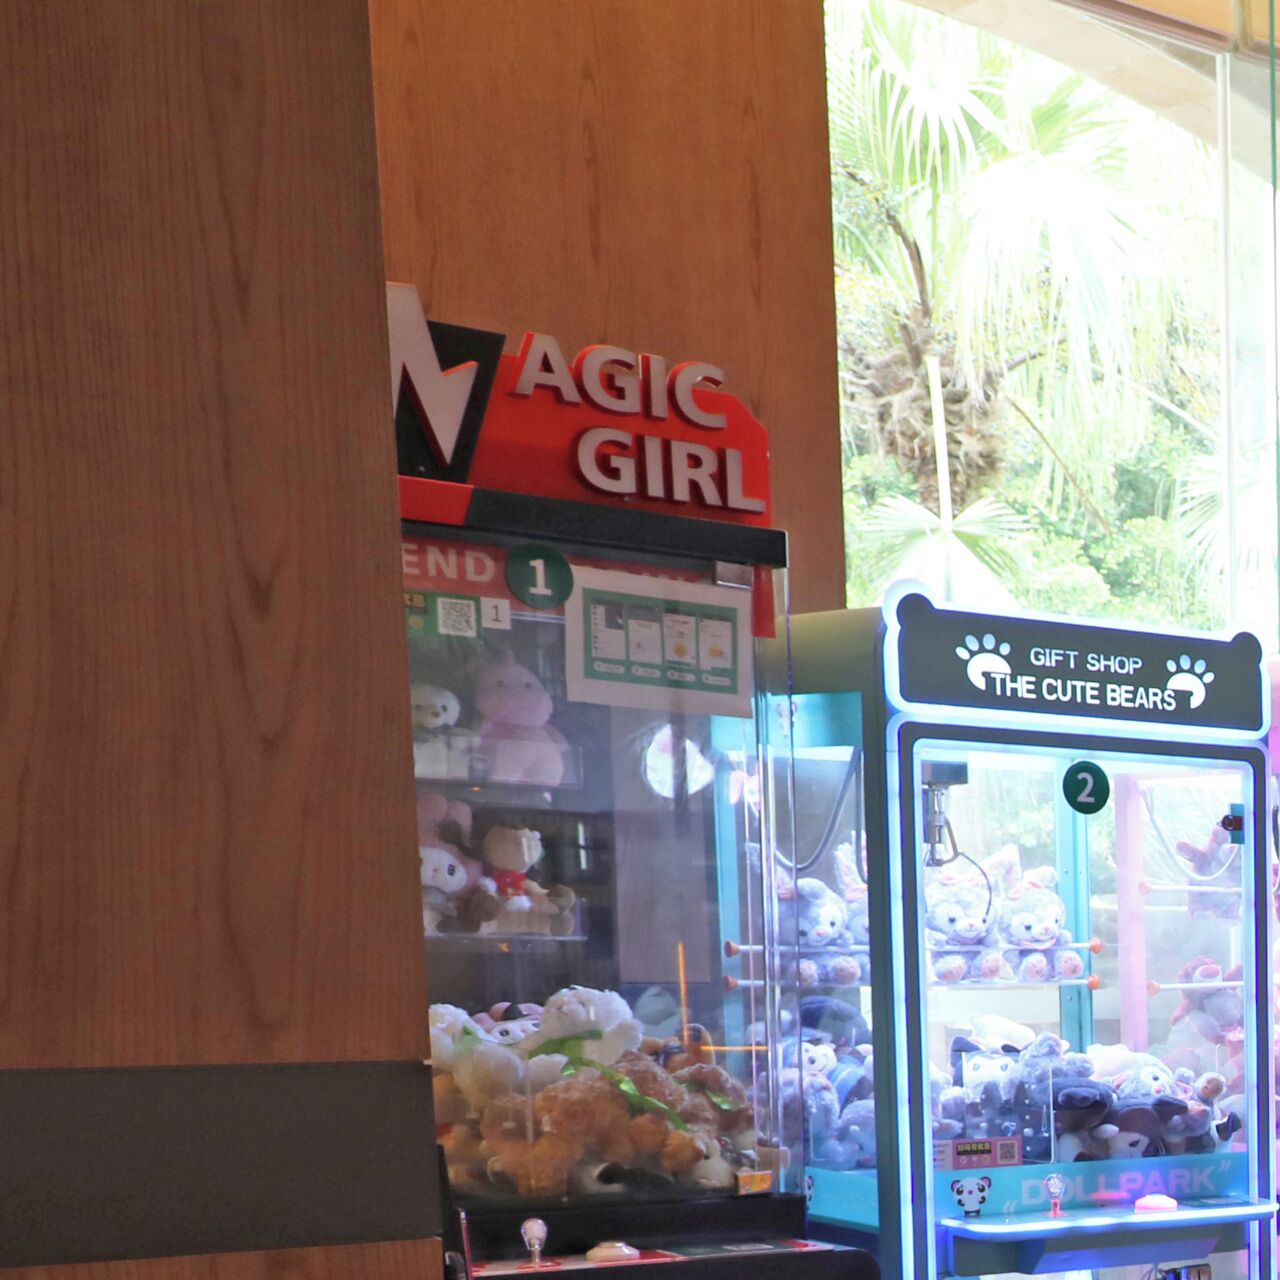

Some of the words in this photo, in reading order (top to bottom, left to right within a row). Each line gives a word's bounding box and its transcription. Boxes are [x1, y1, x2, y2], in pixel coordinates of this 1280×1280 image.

[576, 427, 766, 513] GIRL
[528, 558, 553, 597] 1
[1029, 647, 1079, 671] GIFT
[1086, 653, 1143, 675] SHOP
[991, 672, 1037, 700] THE
[1042, 677, 1100, 706] CUTE
[1106, 683, 1178, 712] BEARS
[1075, 770, 1096, 804] 2
